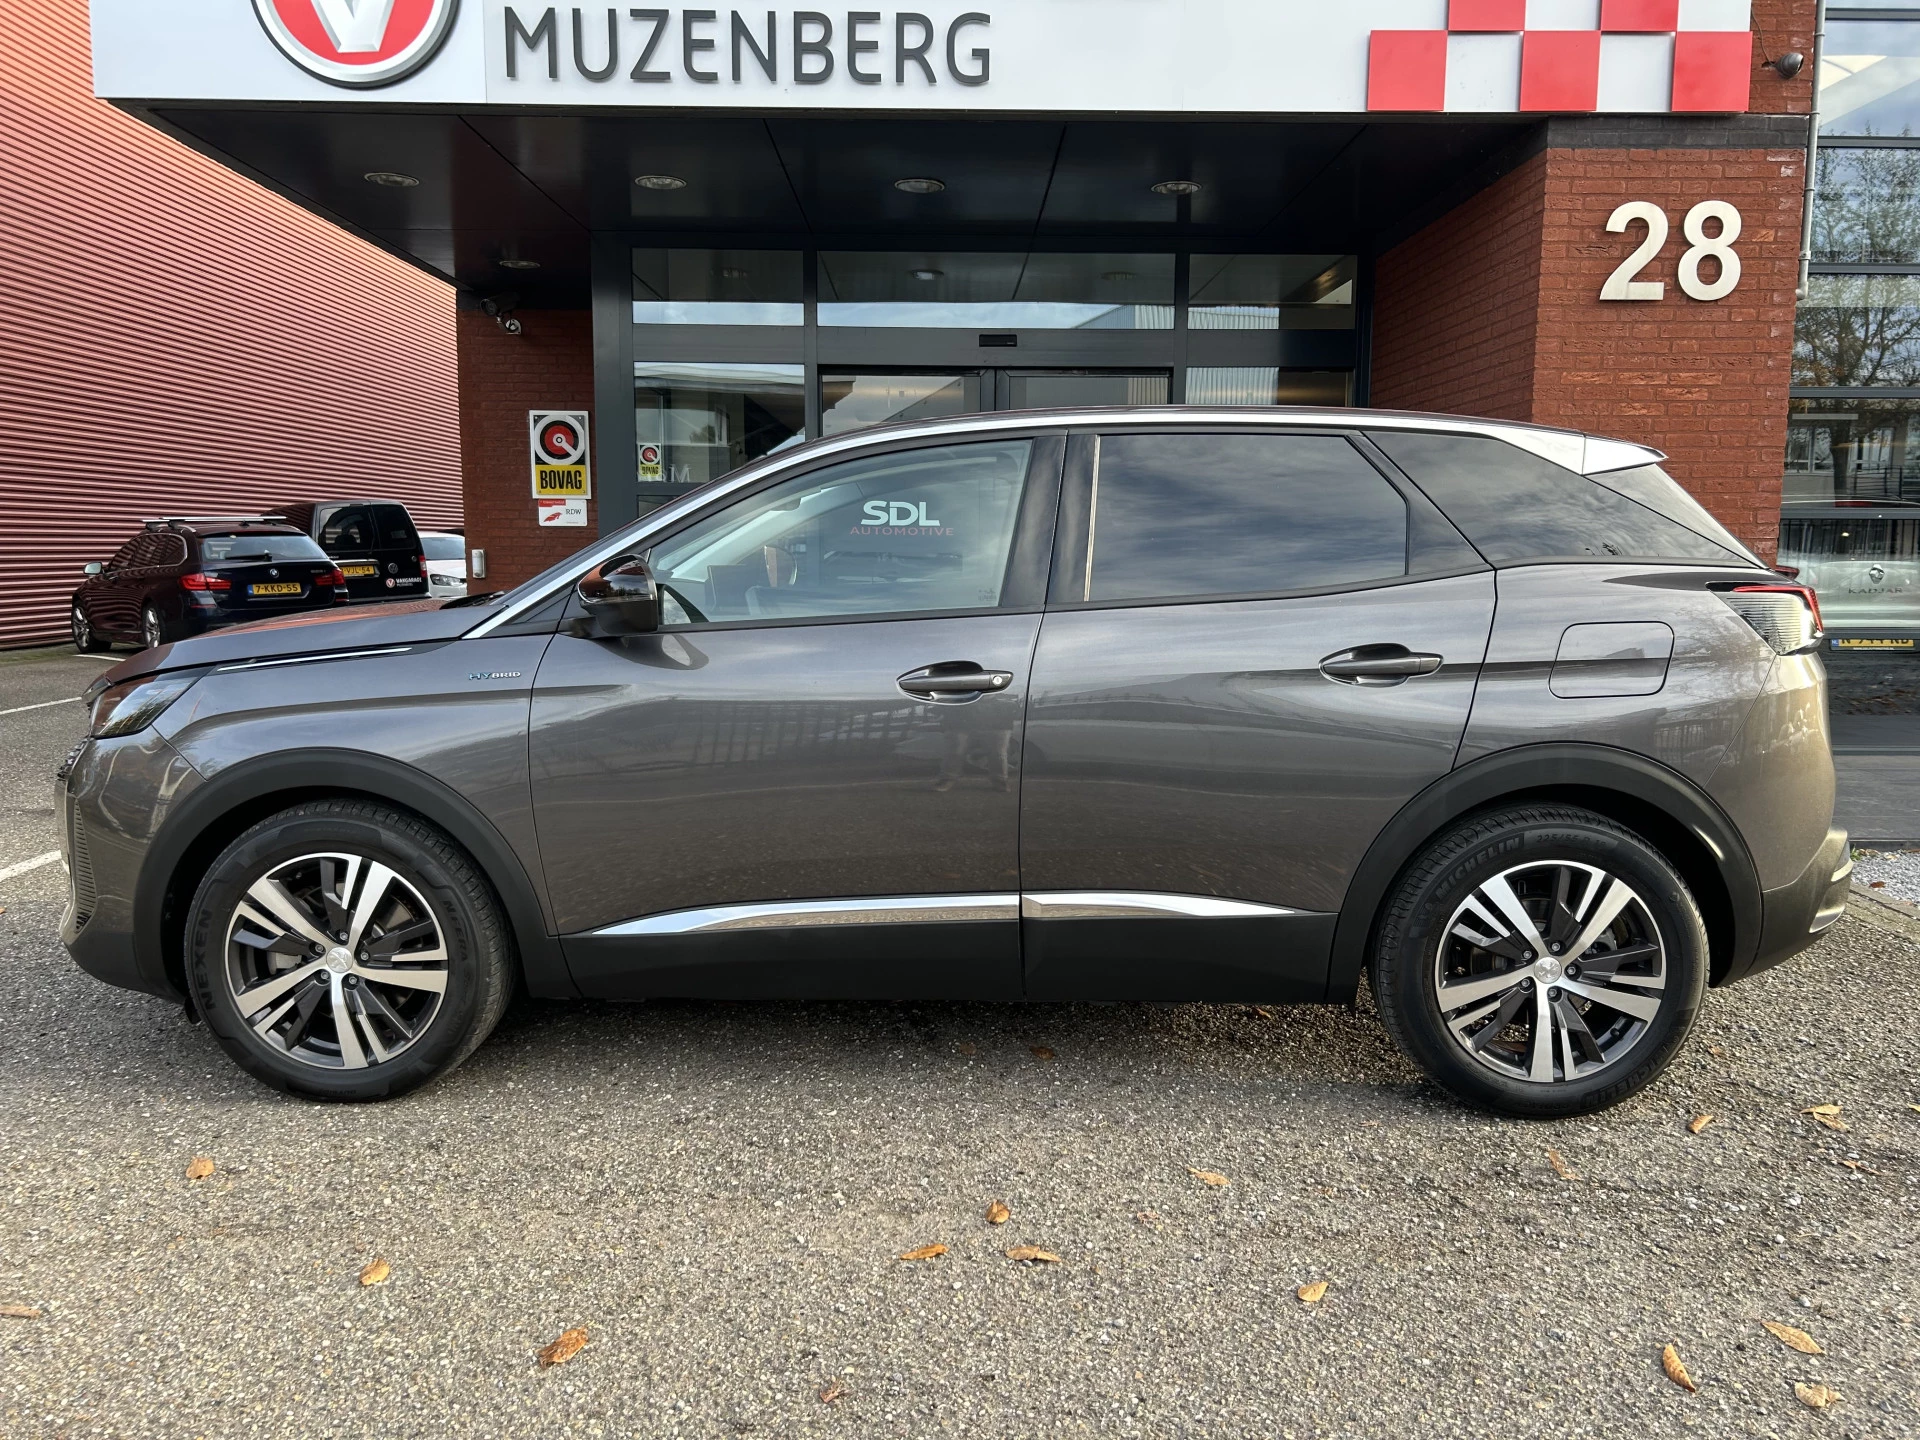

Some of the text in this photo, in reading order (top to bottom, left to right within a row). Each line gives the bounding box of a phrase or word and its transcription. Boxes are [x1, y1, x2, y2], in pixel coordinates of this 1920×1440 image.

[504, 7, 991, 85] MUZENBERG
[1600, 200, 1742, 301] 28
[540, 469, 582, 489] BOVAG
[861, 500, 940, 526] SDL
[850, 526, 954, 536] AUTOMOTIVE
[255, 584, 299, 594] 7-KKD-55
[469, 671, 521, 680] HYBRID
[1436, 837, 1520, 899] MICHELIN
[194, 908, 217, 1010] NEXEN
